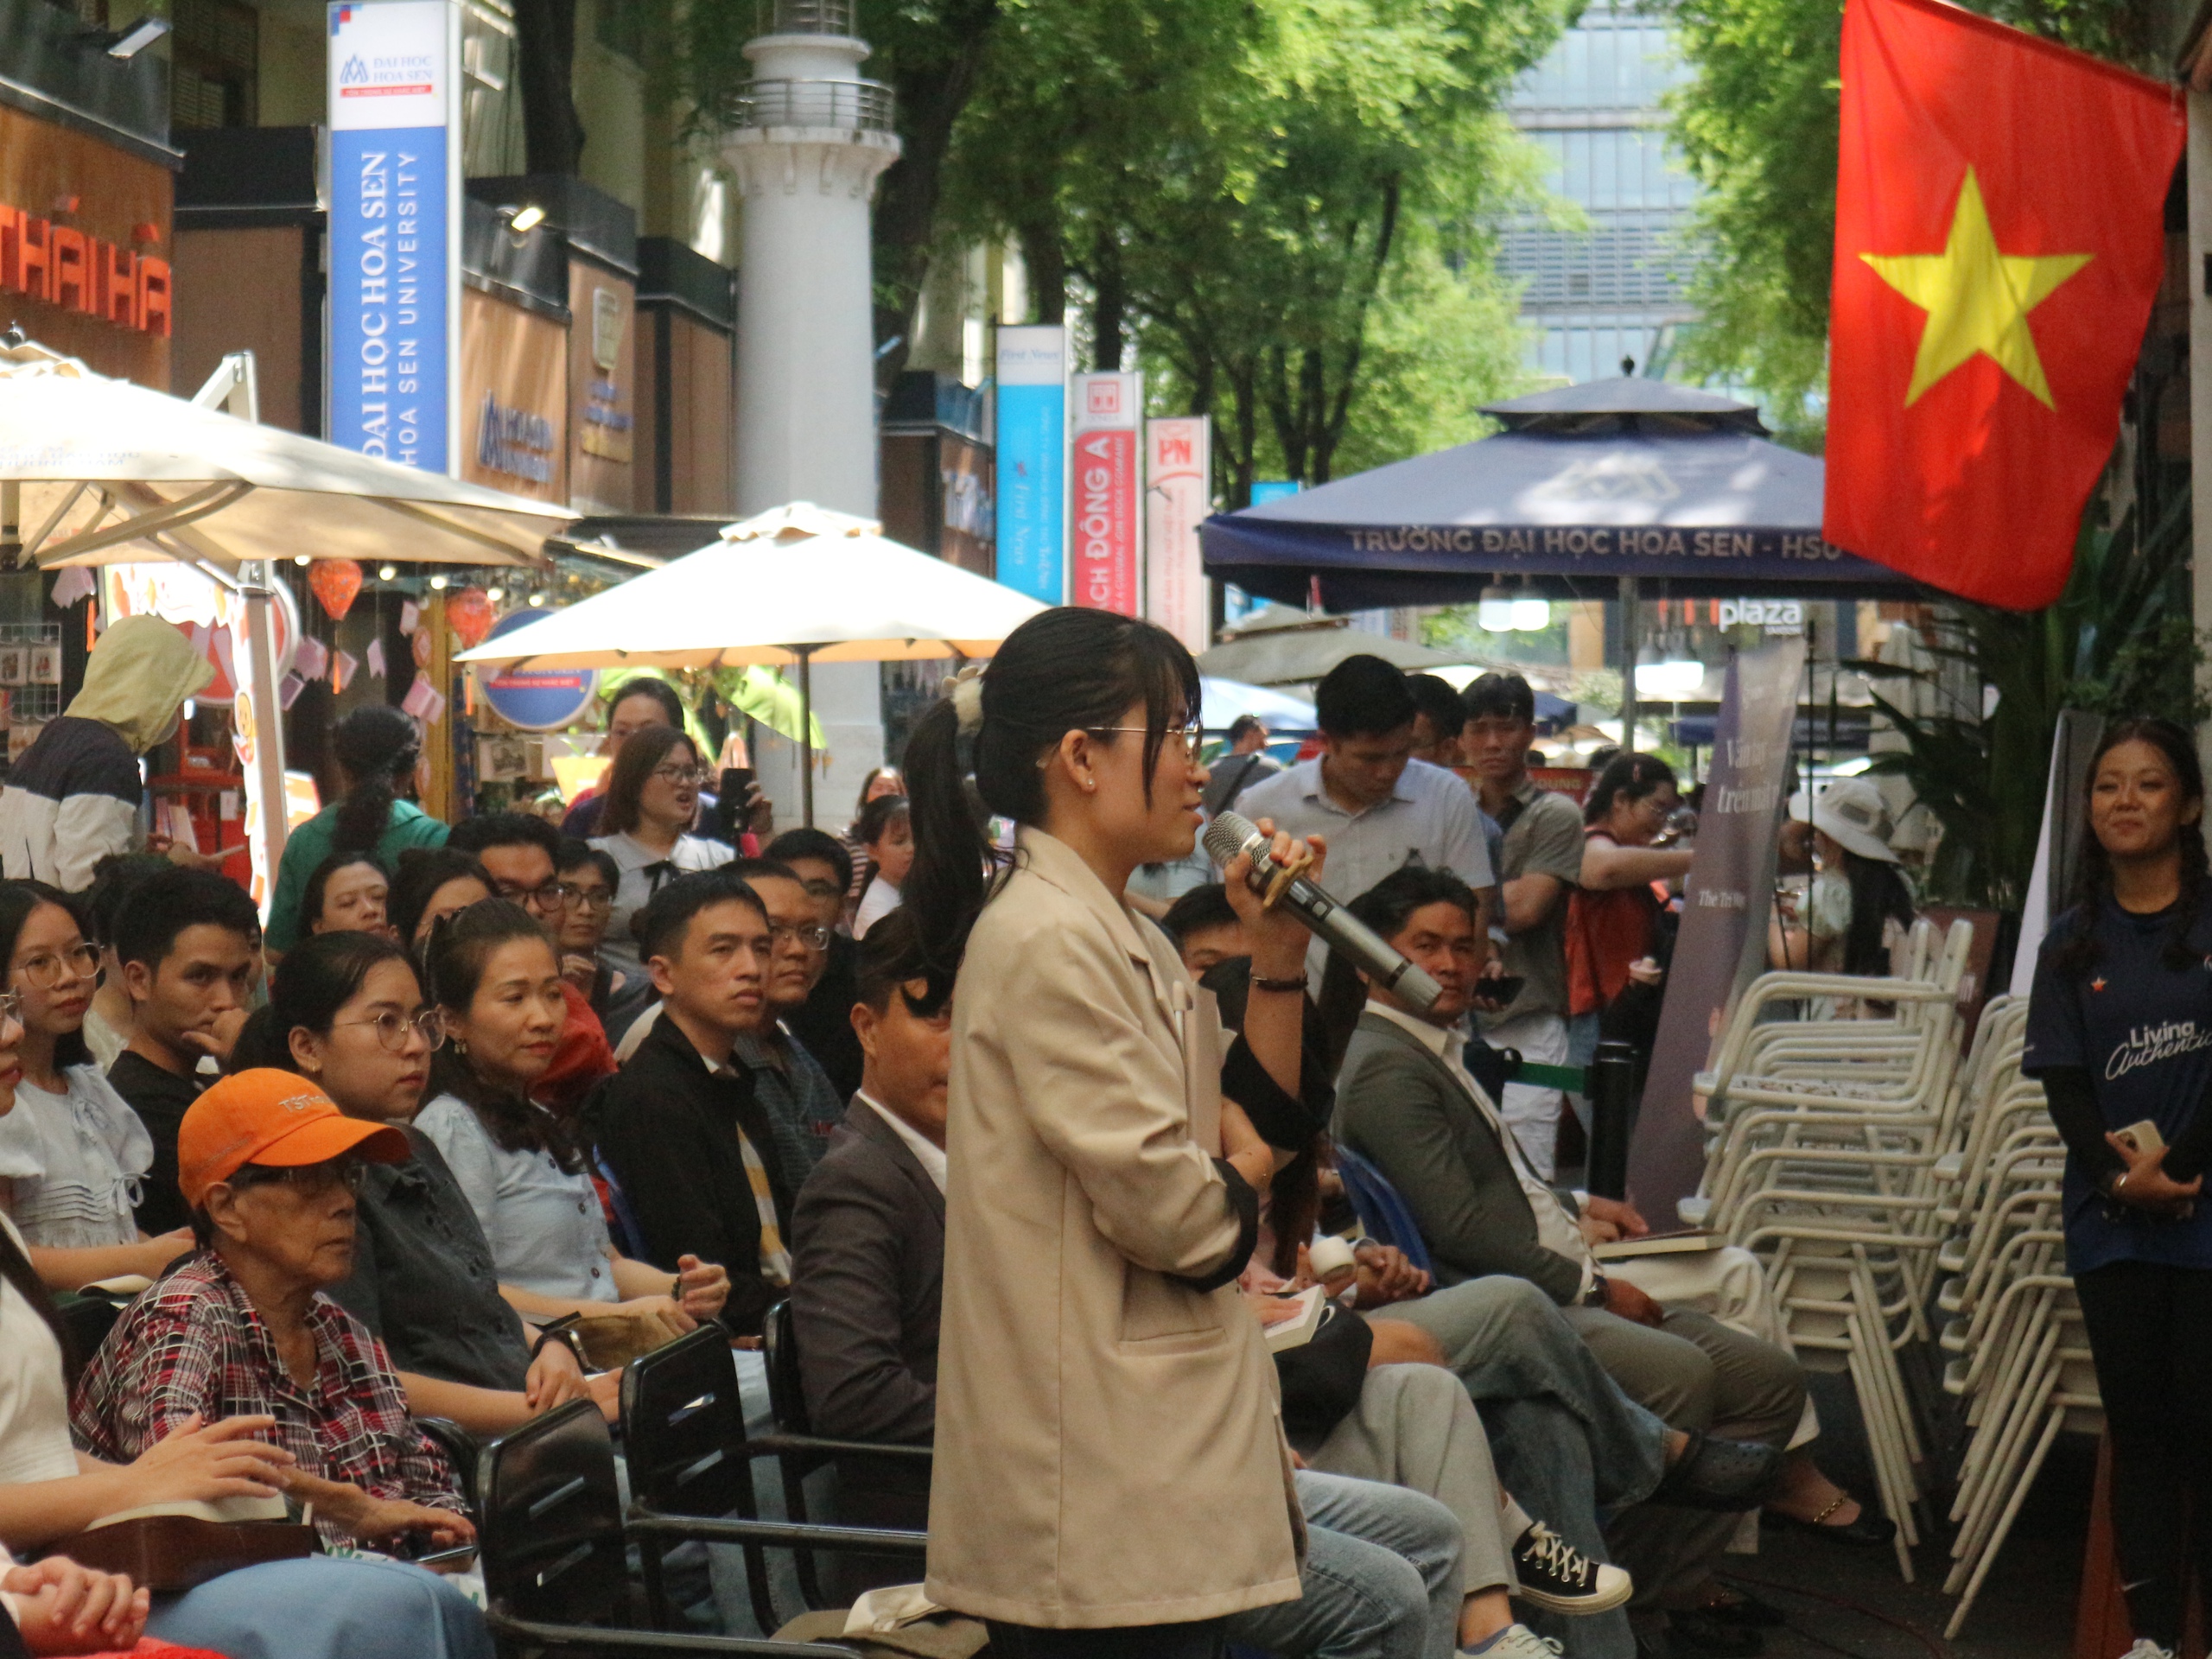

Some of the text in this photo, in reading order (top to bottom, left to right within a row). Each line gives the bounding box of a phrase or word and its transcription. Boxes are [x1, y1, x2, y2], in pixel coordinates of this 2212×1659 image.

[360, 152, 387, 219] SEN
[361, 225, 388, 306] HOA
[397, 152, 418, 467] HOA SEN UNIVERSITY
[361, 312, 390, 395] HỌC
[1084, 436, 1110, 460] A
[1079, 467, 1110, 560] ĐÔNG
[1345, 525, 1473, 552] TRƯỜNG
[1482, 529, 1535, 560] ĐẠI
[1544, 529, 1610, 560] HỌC
[1618, 531, 1685, 556] HOA
[1694, 532, 1754, 557] SEN
[2129, 1020, 2196, 1050] Living
